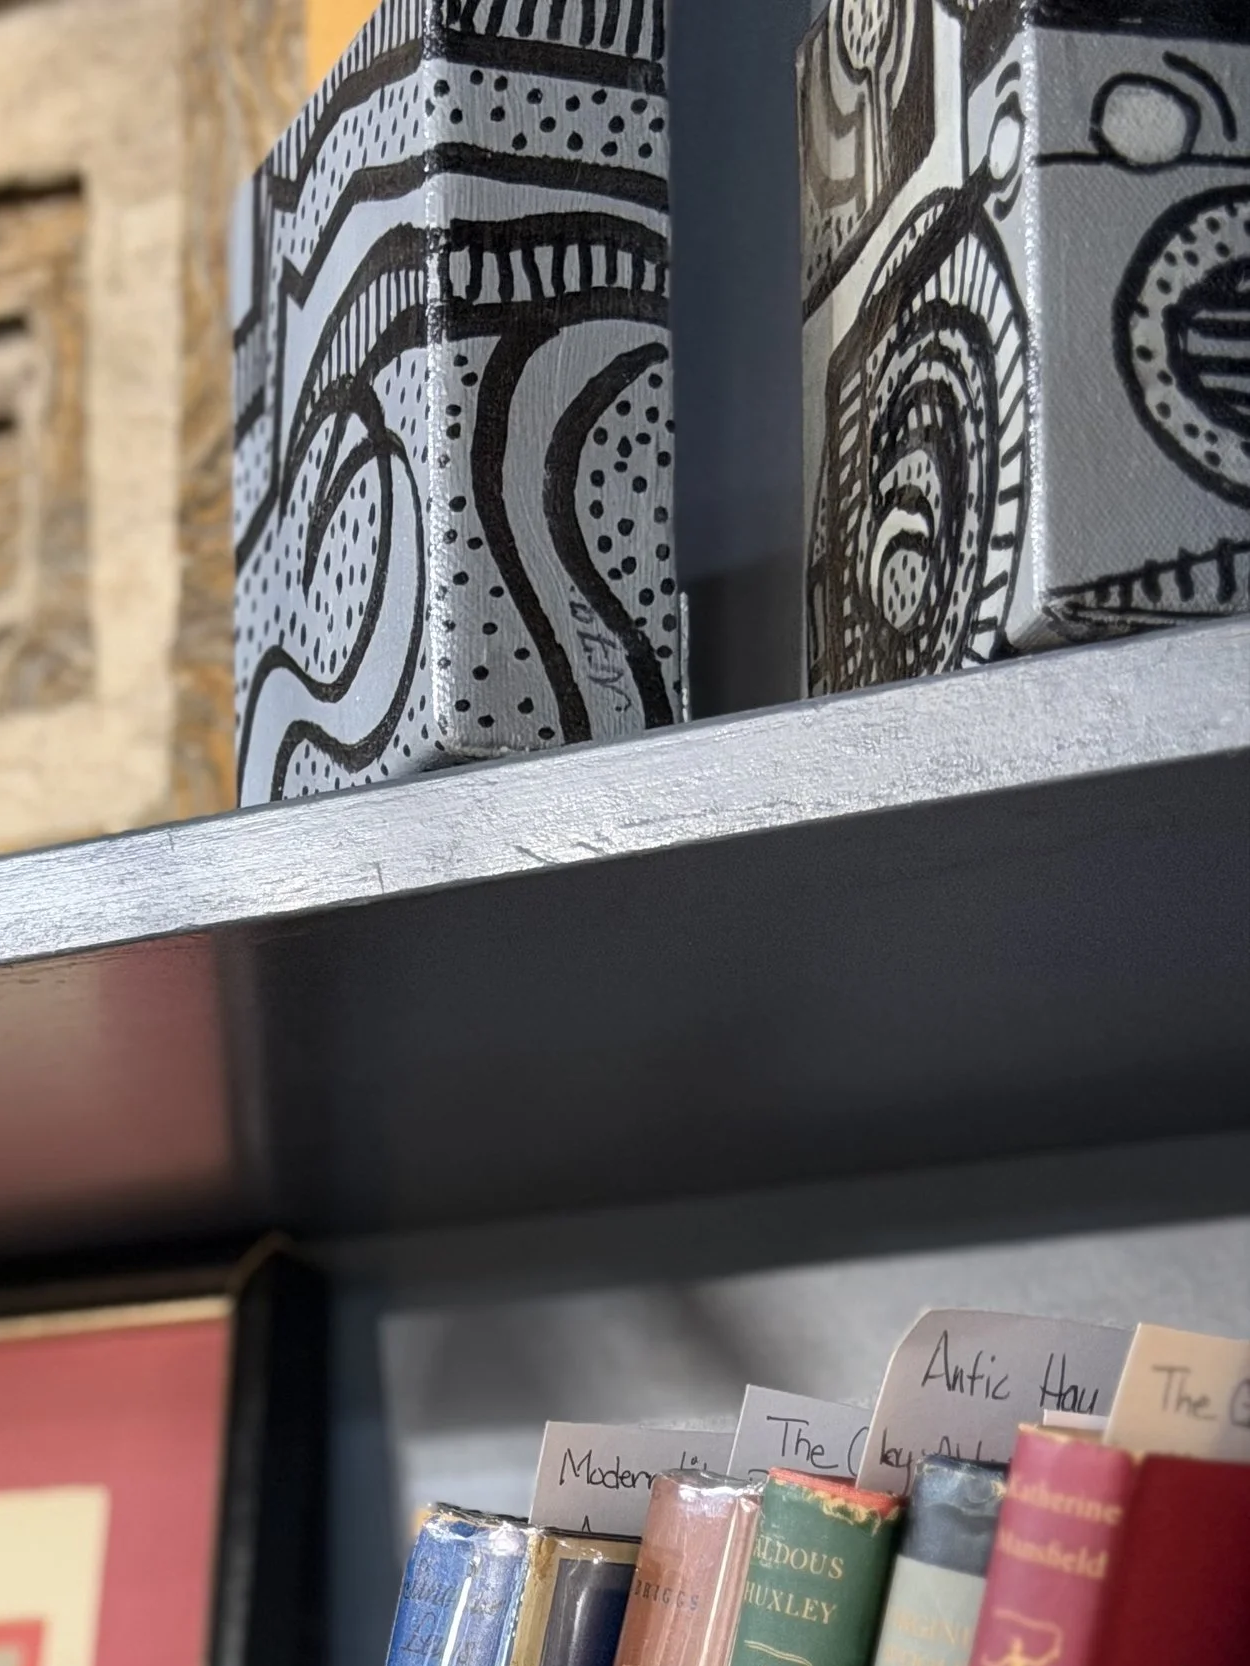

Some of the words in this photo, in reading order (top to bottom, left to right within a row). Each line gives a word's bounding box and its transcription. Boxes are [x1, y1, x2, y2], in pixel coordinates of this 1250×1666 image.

[921, 1329, 1011, 1400] Antic
[1151, 1362, 1219, 1421] The
[766, 1415, 839, 1469] The
[753, 1533, 845, 1580] ALDOUS
[744, 1580, 838, 1625] HUXLEY
